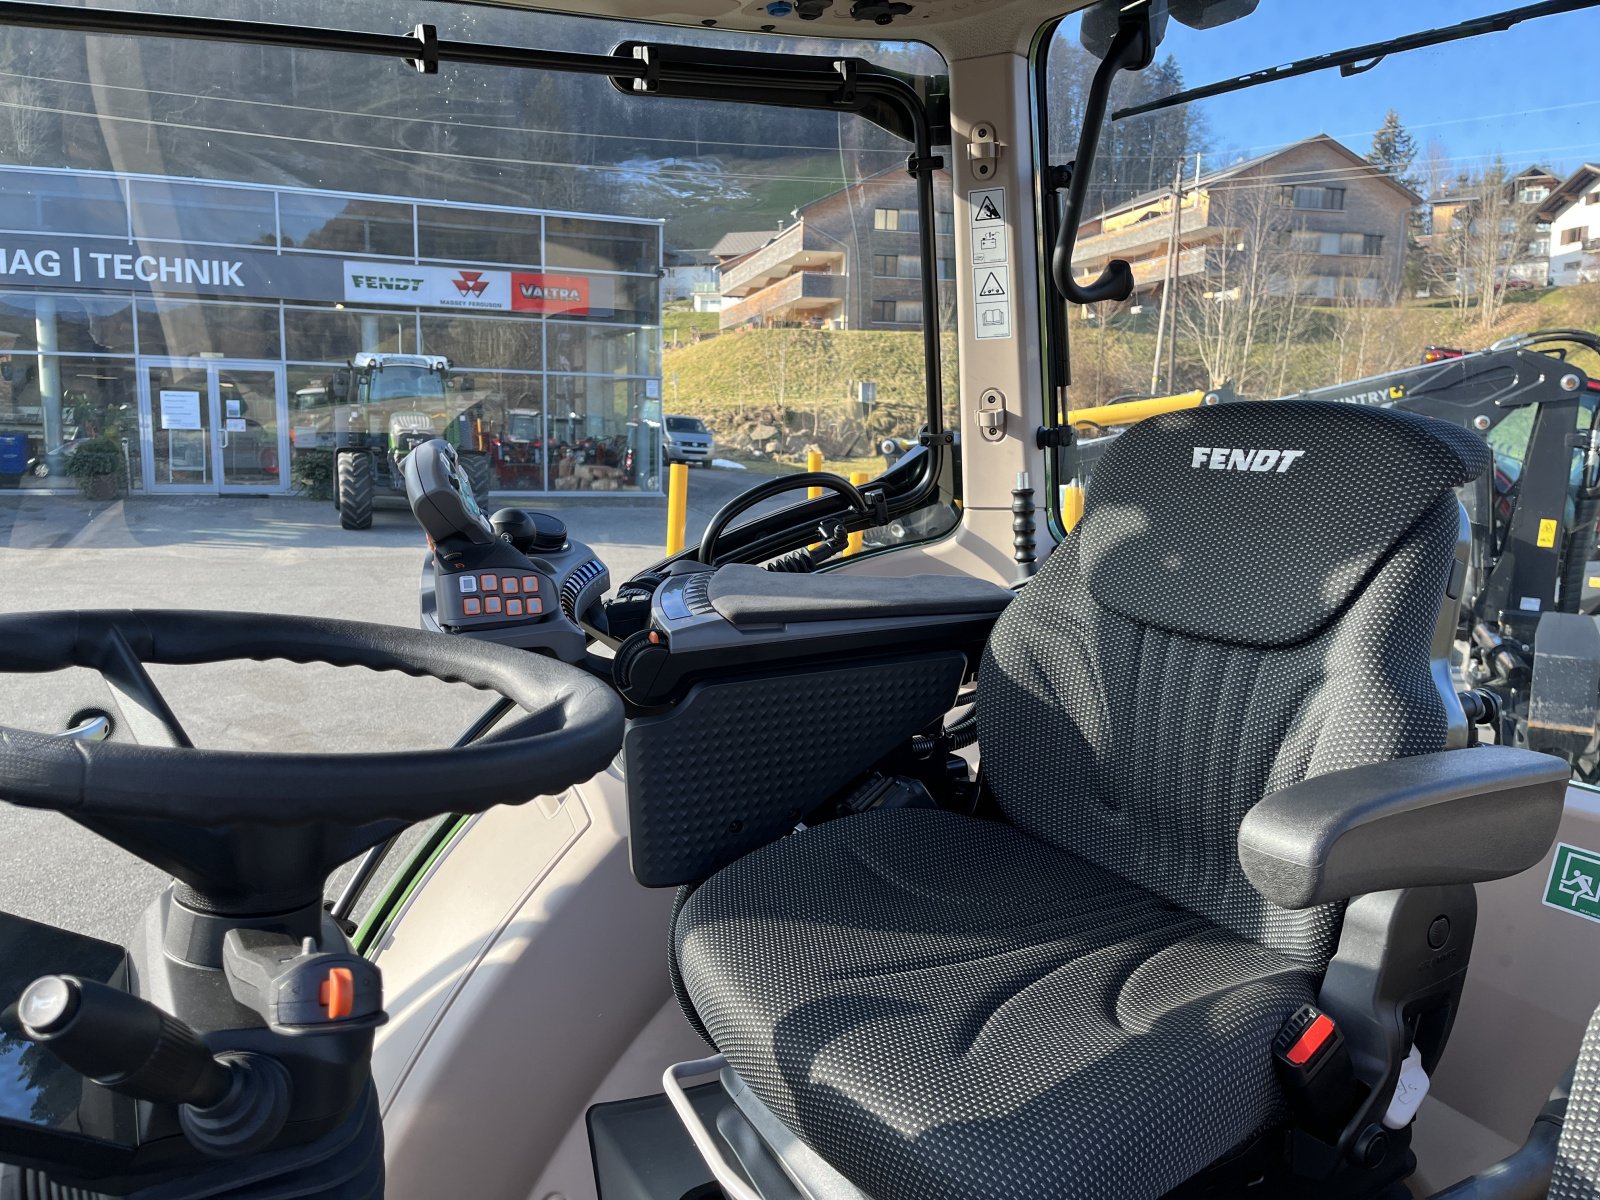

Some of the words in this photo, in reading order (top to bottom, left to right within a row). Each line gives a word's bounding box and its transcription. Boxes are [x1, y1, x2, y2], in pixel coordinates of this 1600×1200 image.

[89, 252, 245, 287] TECHNIK
[351, 274, 424, 291] FENDT
[519, 283, 581, 302] VALTRA
[440, 299, 467, 307] MASSEY
[468, 300, 503, 308] FERGUSON
[1191, 446, 1306, 472] FENDT
